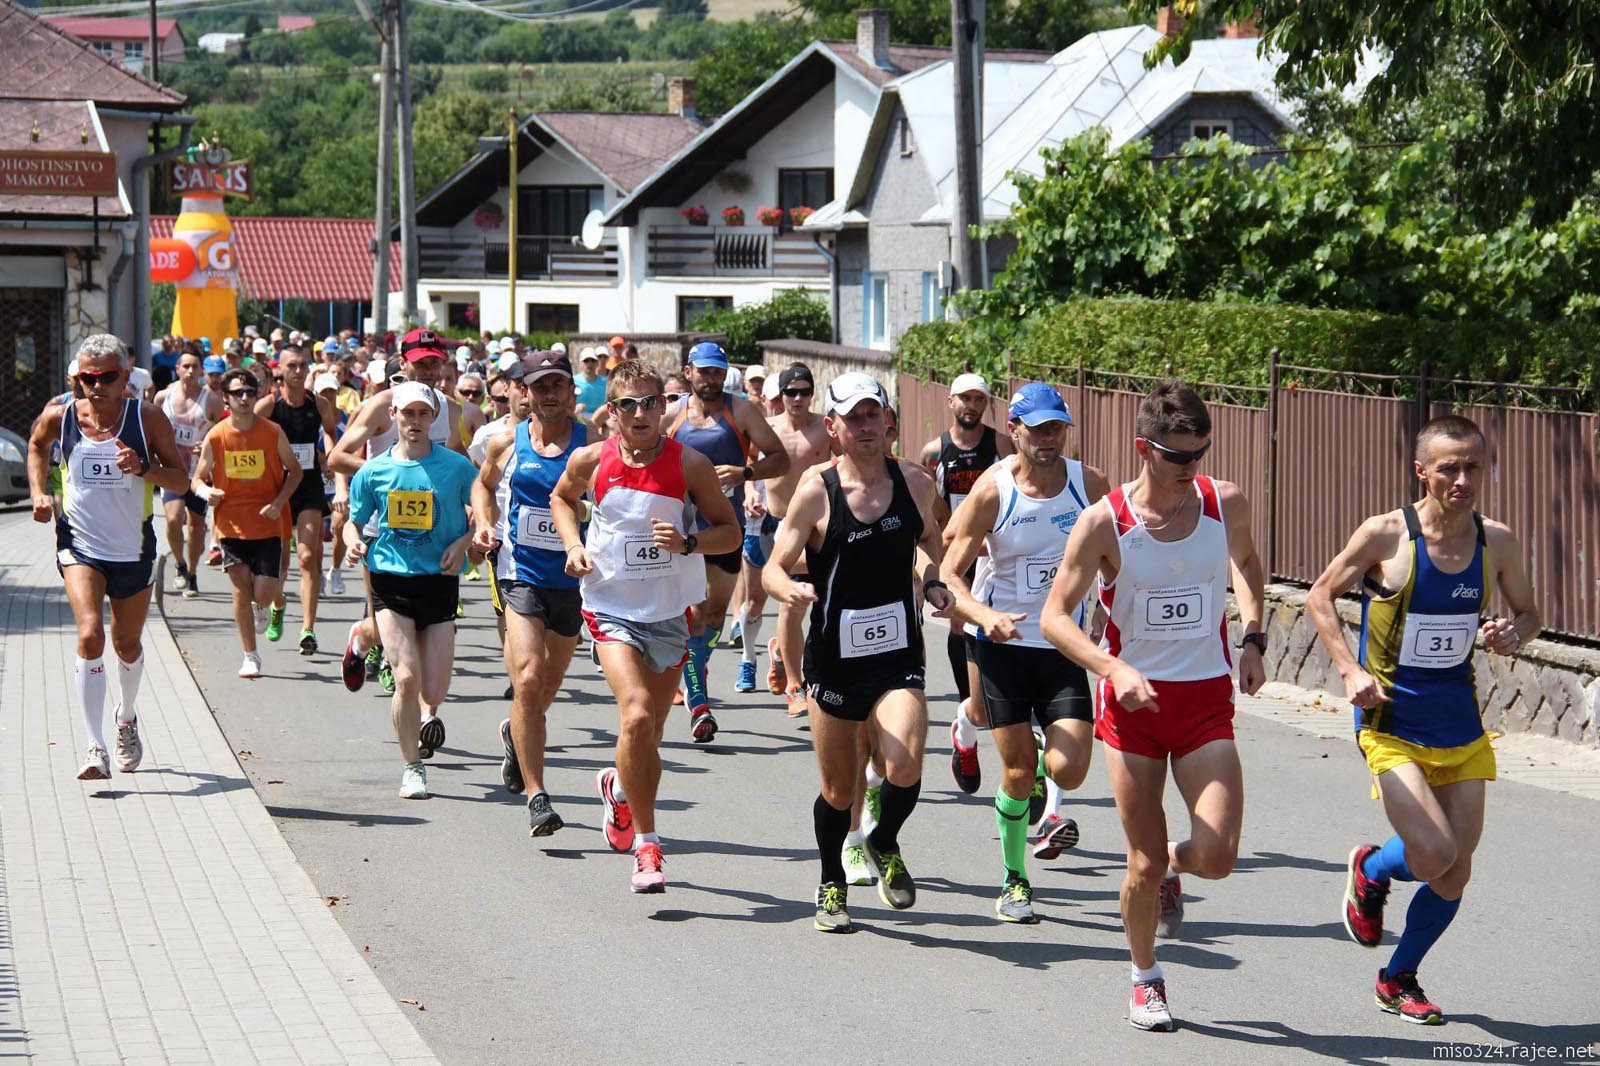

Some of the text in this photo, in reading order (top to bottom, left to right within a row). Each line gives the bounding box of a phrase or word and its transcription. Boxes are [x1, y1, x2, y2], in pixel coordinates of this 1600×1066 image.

[5, 173, 85, 187] MAKOVICA
[208, 241, 231, 270] G
[232, 455, 257, 467] 158
[92, 464, 112, 475] 91
[396, 500, 428, 517] 152
[538, 521, 557, 534] 60
[636, 546, 660, 560] 48
[1039, 566, 1058, 583] 20
[1162, 603, 1189, 619] 30
[864, 625, 887, 640] 65
[1429, 636, 1454, 651] 31
